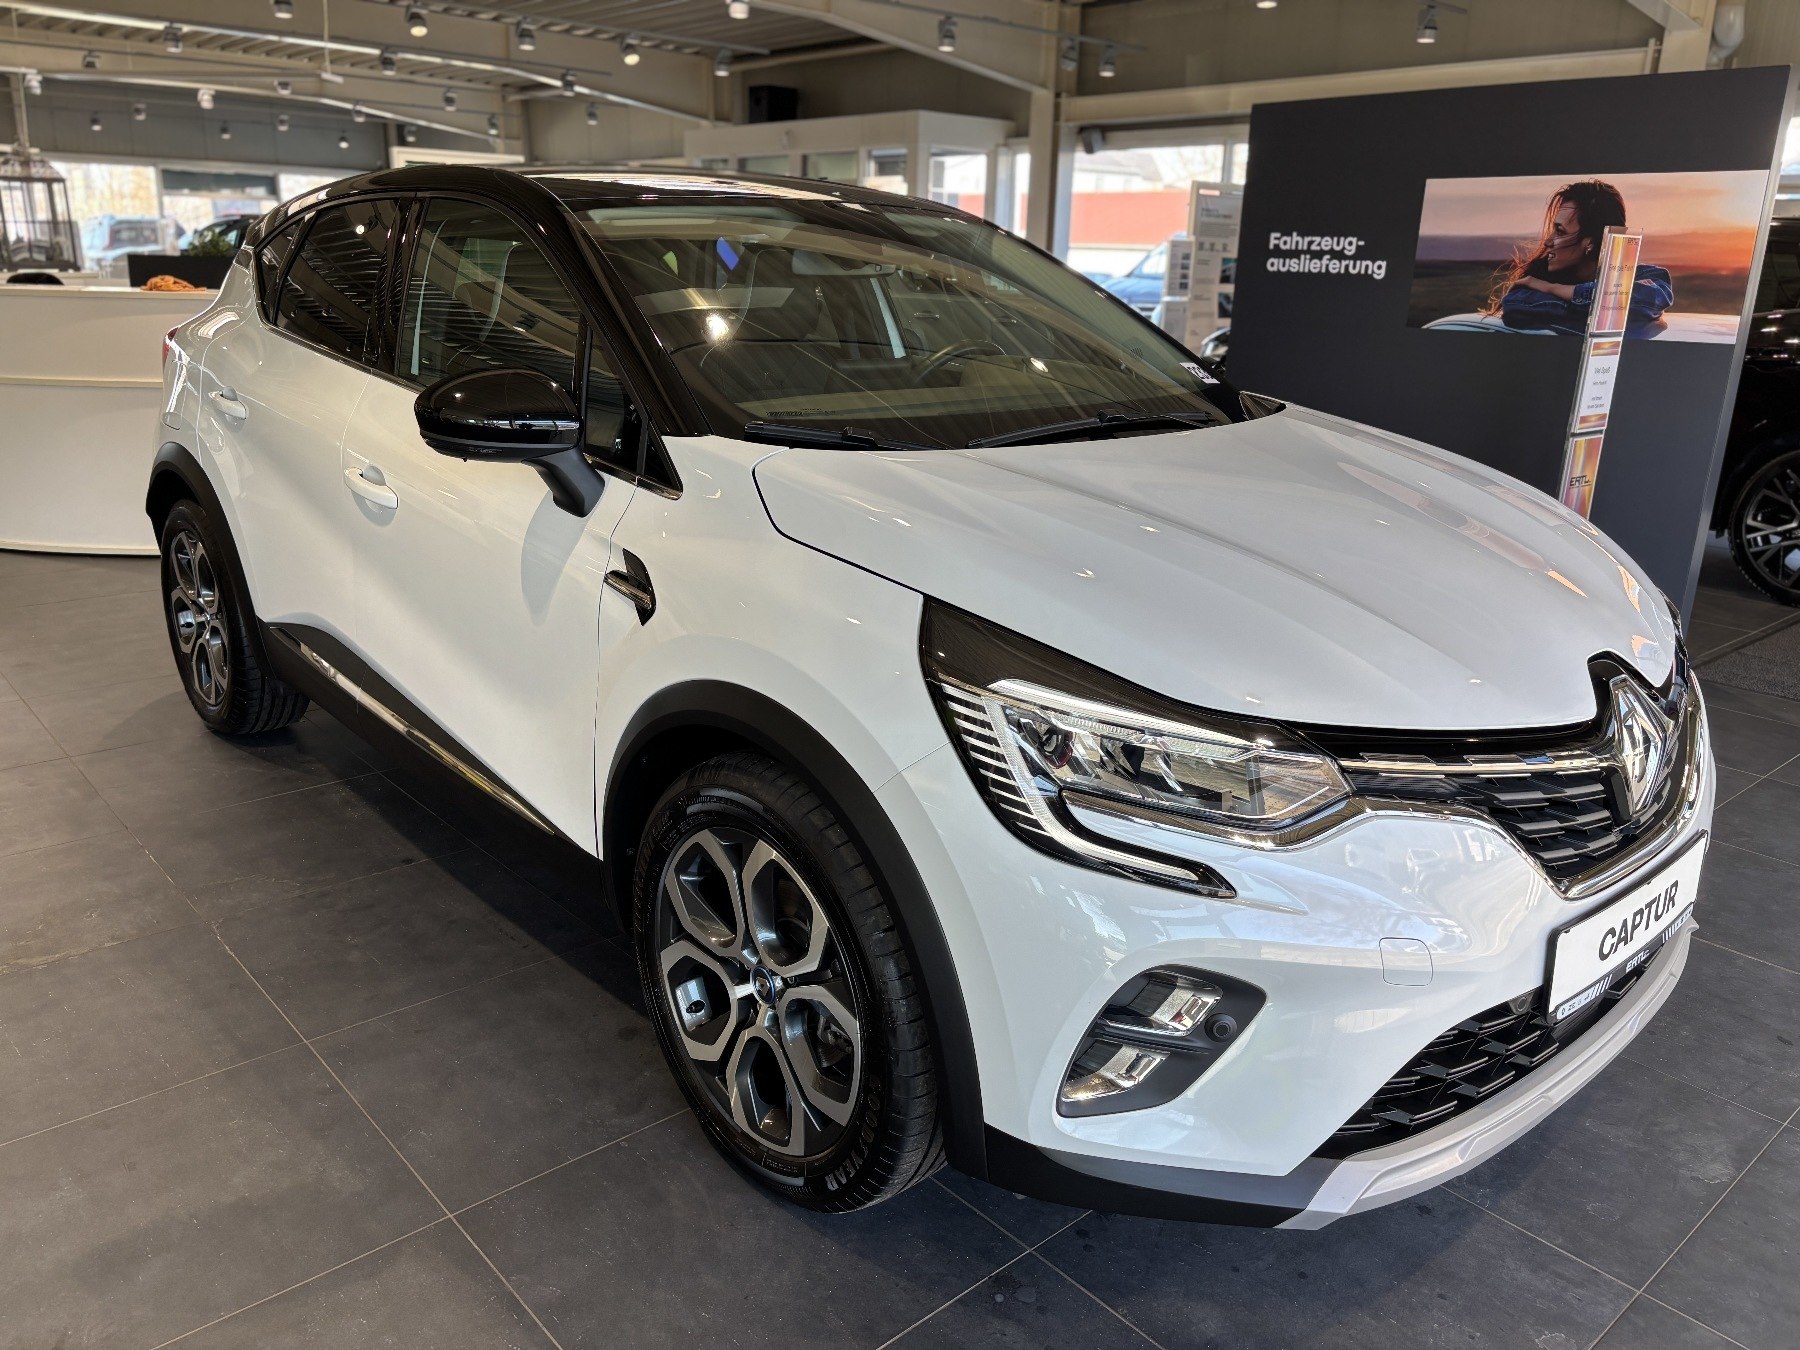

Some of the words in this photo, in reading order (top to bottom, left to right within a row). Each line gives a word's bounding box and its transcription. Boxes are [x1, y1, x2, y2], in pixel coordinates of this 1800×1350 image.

[1268, 231, 1365, 256] Fahrzeug-
[1266, 254, 1387, 280] auslieferung
[1598, 879, 1679, 961] CAPTUR
